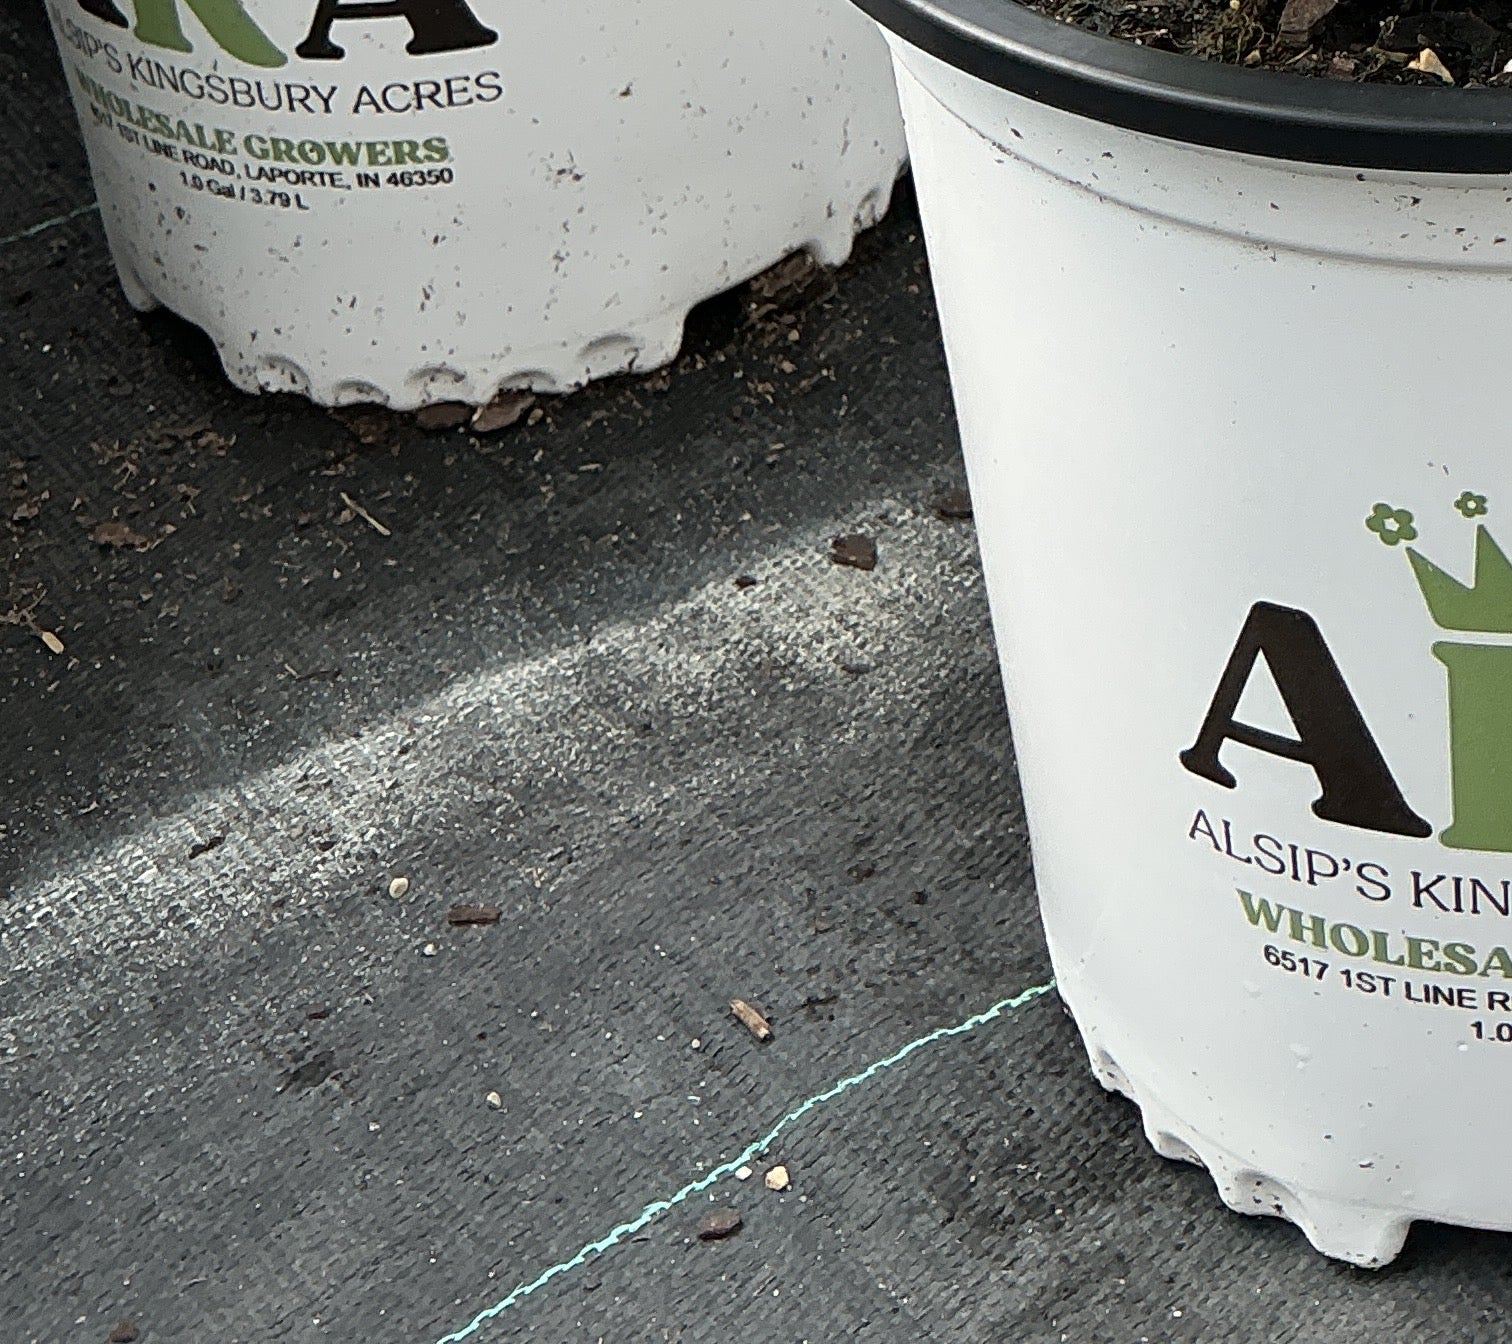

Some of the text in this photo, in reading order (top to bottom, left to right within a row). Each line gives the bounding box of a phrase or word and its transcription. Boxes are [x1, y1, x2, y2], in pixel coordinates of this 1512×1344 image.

[126, 52, 338, 114] KINGSBURY
[352, 70, 503, 114] ACRES
[243, 134, 450, 167] GROWERS
[295, 192, 310, 211] L
[357, 172, 381, 189] IN
[386, 167, 454, 188] 46350
[1188, 808, 1392, 902] ALSIP'S
[1263, 944, 1330, 981] 6517
[1339, 968, 1396, 997] 1ST
[1405, 981, 1478, 1010] LINE
